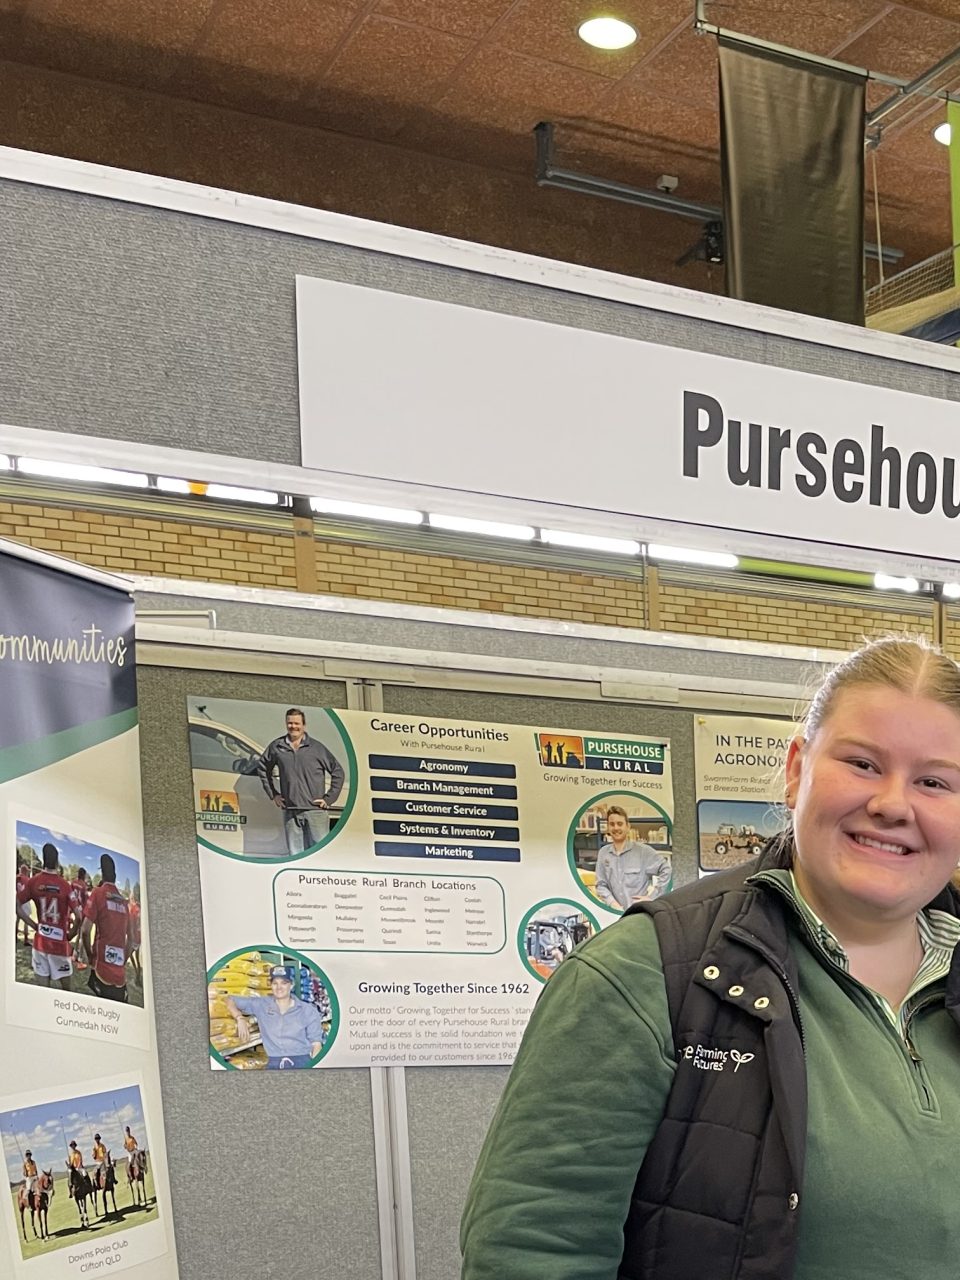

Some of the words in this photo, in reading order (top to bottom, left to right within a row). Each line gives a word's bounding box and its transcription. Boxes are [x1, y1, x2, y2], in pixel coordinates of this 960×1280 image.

[0, 624, 127, 666] ommunities
[370, 719, 414, 734] Career
[418, 723, 508, 742] Opportunities
[400, 740, 418, 750] With
[422, 742, 468, 752] Pursehouse
[716, 735, 730, 746] IN
[735, 736, 762, 748] THE
[588, 742, 661, 758] PURSEHOUSE
[420, 760, 468, 774] Agronomy
[603, 760, 650, 772] RURAL
[397, 780, 430, 791] Branch
[432, 782, 493, 796] Management
[544, 773, 578, 784] Growing
[581, 776, 616, 786] Together
[619, 778, 630, 786] for
[632, 779, 662, 789] Success
[406, 802, 450, 814] Customer
[452, 806, 487, 816] Service
[196, 814, 246, 823] PURSEHOUSE
[400, 823, 438, 835] Systems
[442, 826, 448, 834] &
[451, 827, 495, 838] Inventory
[426, 846, 473, 858] Marketing
[299, 875, 356, 886] Pursehouse
[363, 878, 387, 887] Rural
[393, 879, 426, 888] Branch
[432, 881, 476, 891] Locations
[359, 982, 410, 995] Growing
[413, 983, 463, 995] Together
[468, 983, 497, 993] Since
[502, 984, 529, 993] 1962
[54, 1000, 70, 1009] Red
[73, 1003, 96, 1014] Devils
[98, 1008, 120, 1021] Rugby
[349, 1006, 364, 1014] Our
[433, 1007, 465, 1015] Together
[56, 1016, 99, 1031] Gunnedah
[101, 1024, 118, 1034] NSW
[371, 1053, 406, 1062] provided
[68, 1251, 94, 1263] Downs
[95, 1246, 111, 1255] Polo
[112, 1240, 128, 1250] Club
[81, 1261, 104, 1272] Clifton
[105, 1254, 121, 1265] QLD
